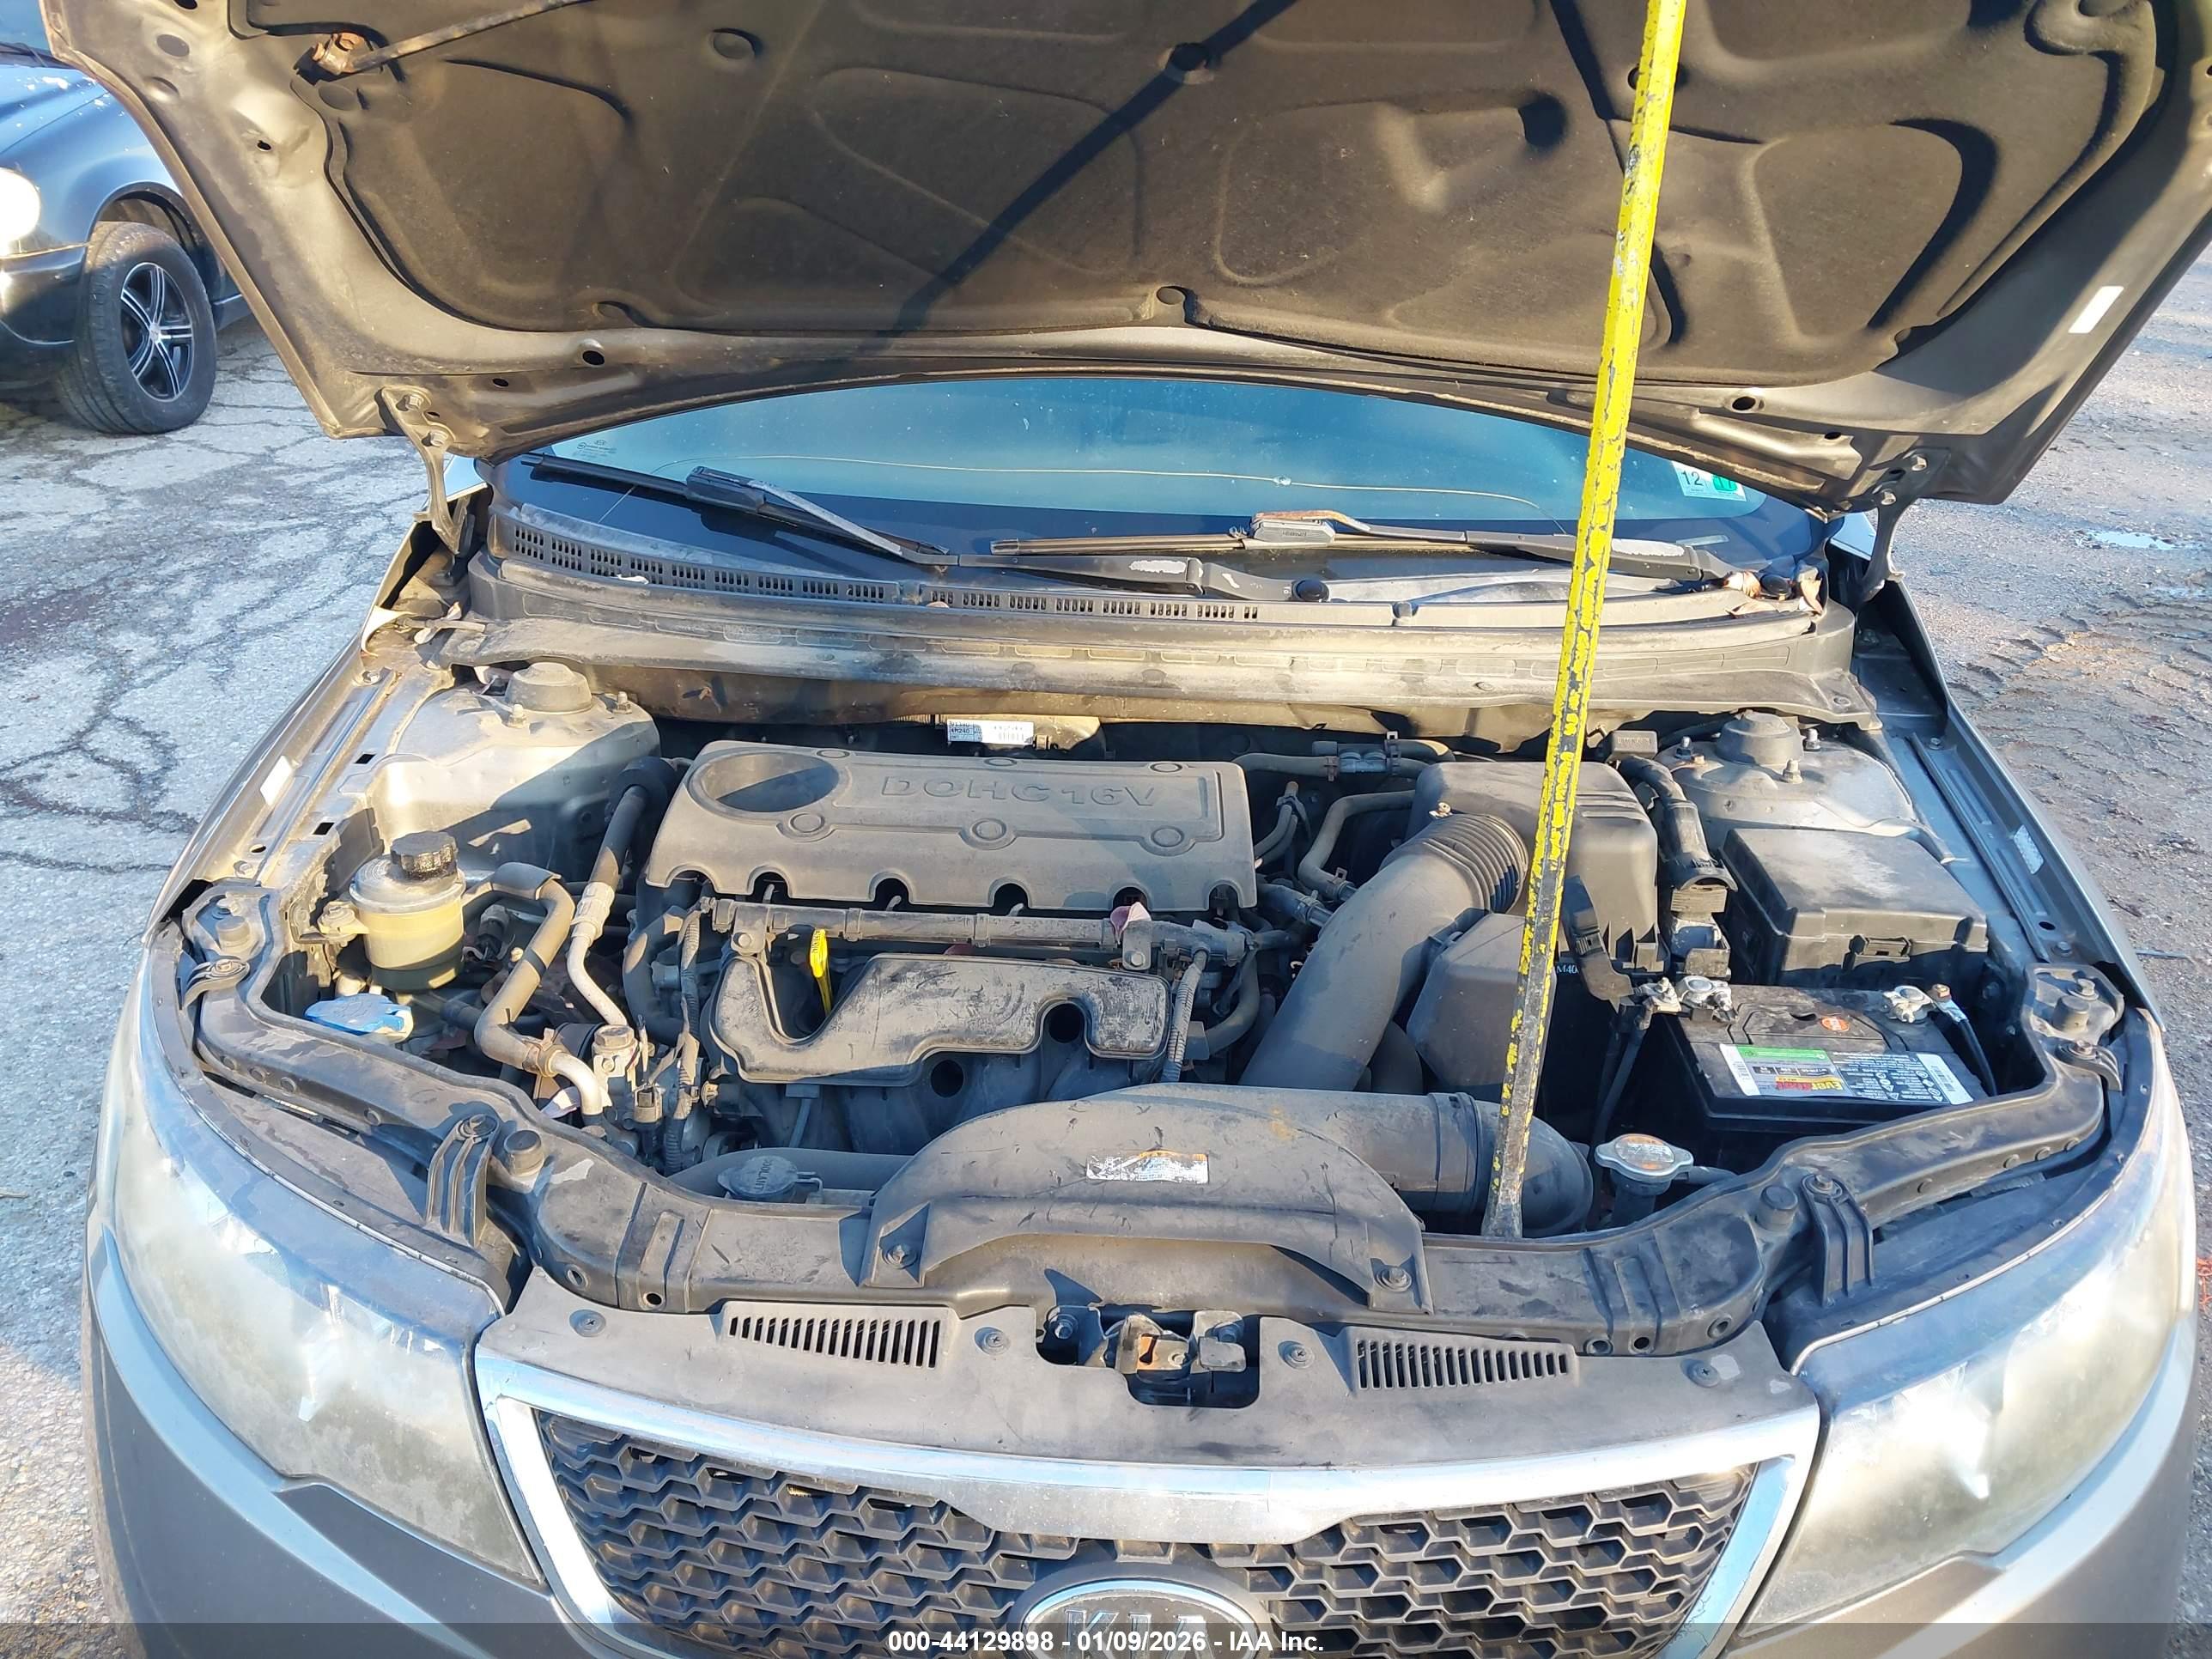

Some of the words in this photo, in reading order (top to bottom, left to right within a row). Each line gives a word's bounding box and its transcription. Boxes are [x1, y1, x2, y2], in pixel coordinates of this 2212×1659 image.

[1681, 470, 1704, 486] 12
[881, 775, 1050, 802] DOHC
[1061, 785, 1155, 806] 16V
